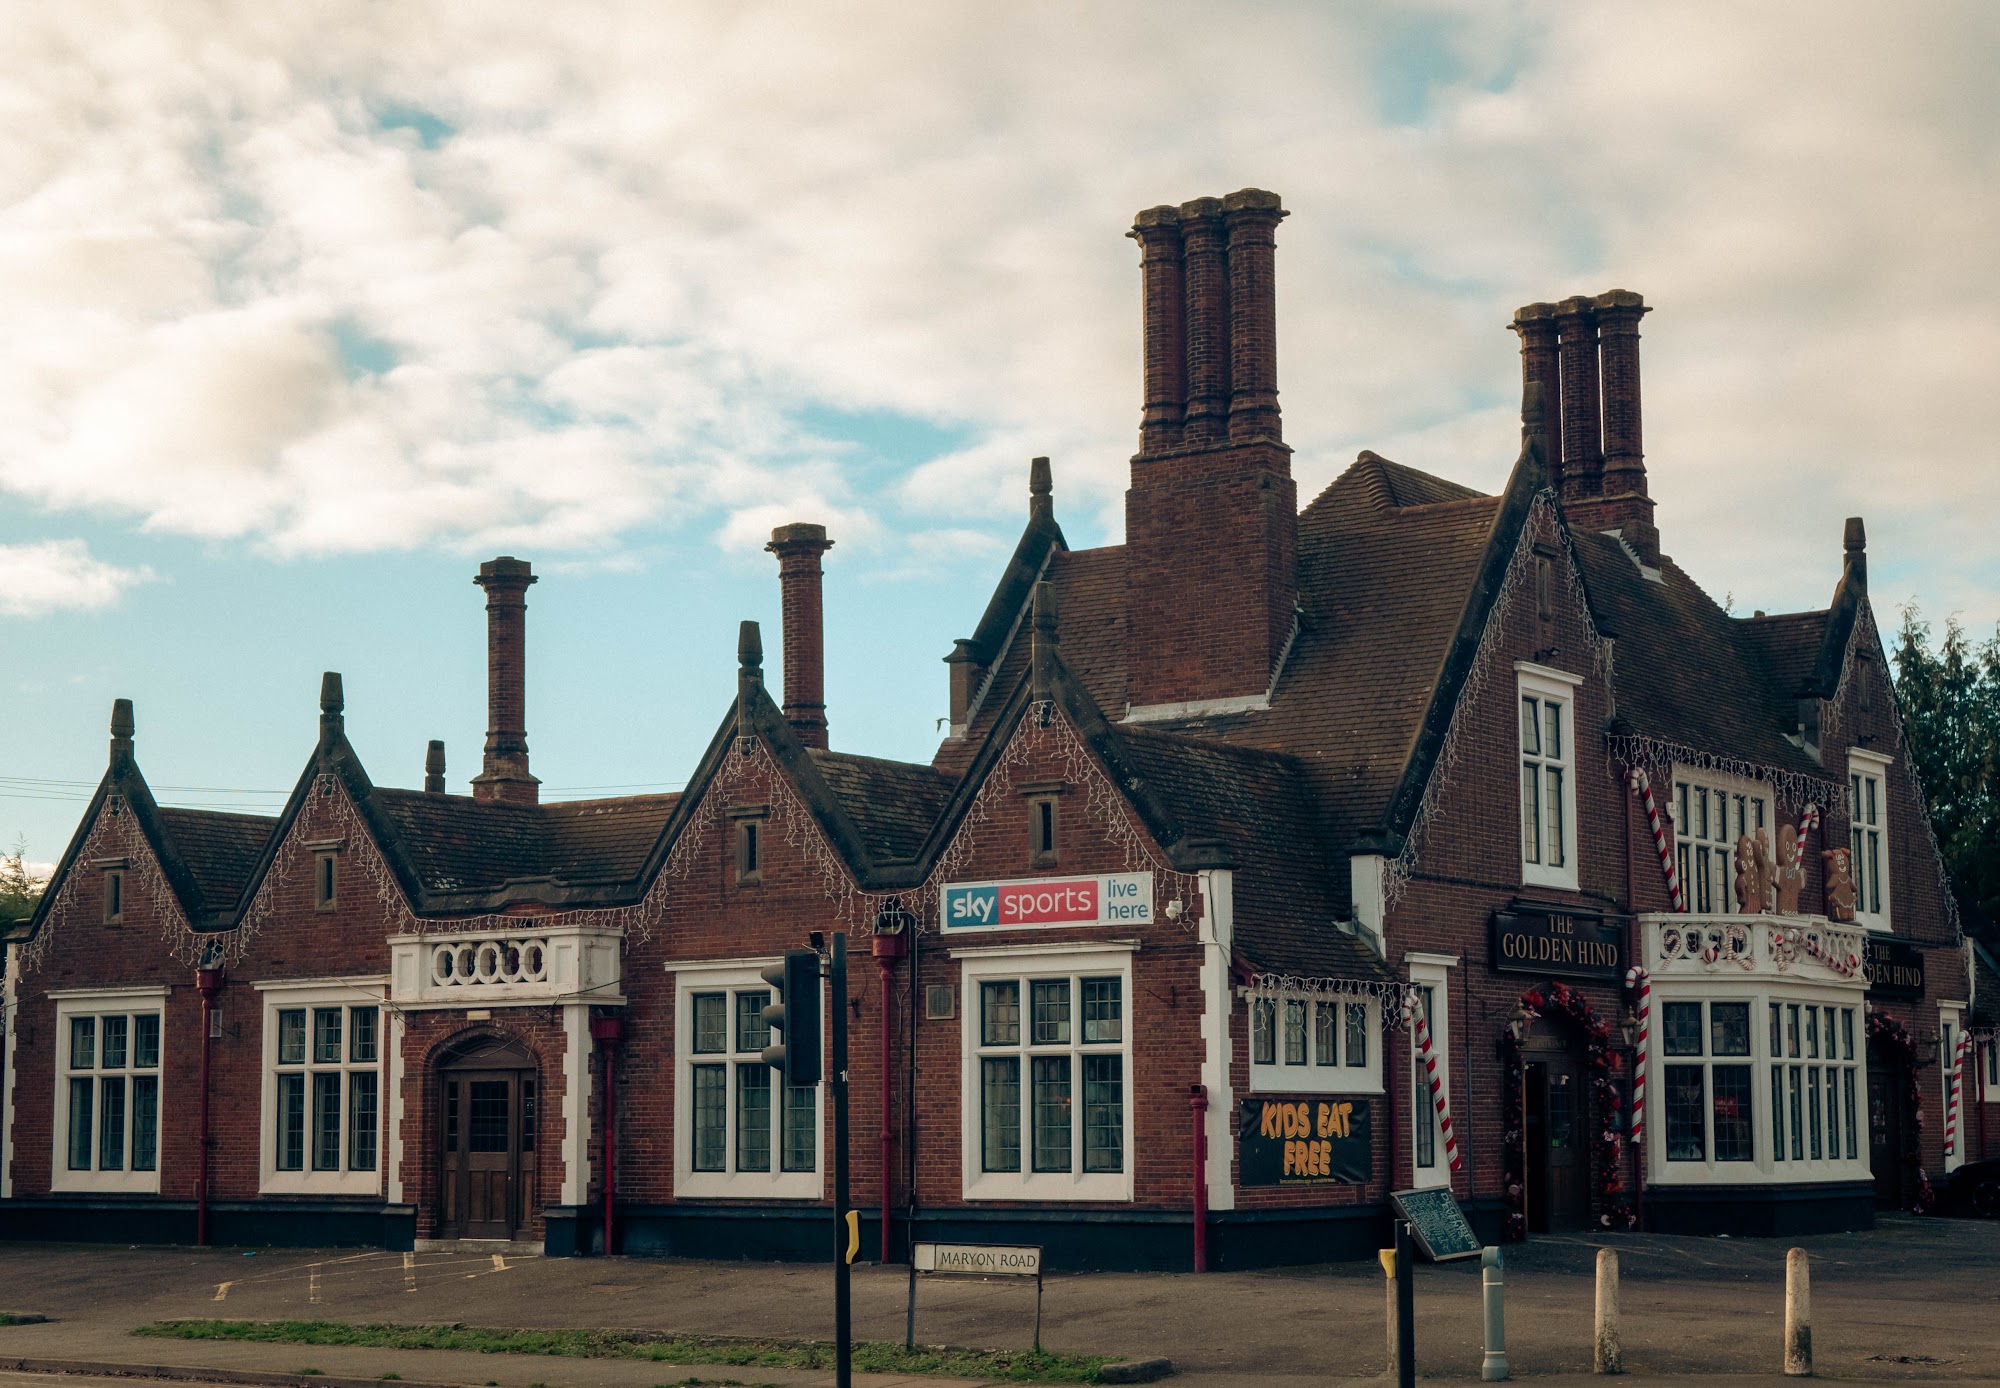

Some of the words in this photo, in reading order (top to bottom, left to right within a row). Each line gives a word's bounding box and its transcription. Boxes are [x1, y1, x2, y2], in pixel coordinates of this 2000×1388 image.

[1107, 879, 1138, 898] live
[953, 891, 995, 923] sky
[1004, 887, 1092, 921] sports
[1107, 901, 1149, 919] here
[1548, 914, 1574, 935] THE
[1502, 932, 1573, 963] GOLDEN
[1577, 940, 1618, 967] HIND
[1873, 944, 1891, 961] THE
[1868, 963, 1891, 984] DEN
[1893, 965, 1921, 987] HIND
[1261, 1101, 1311, 1139] KIDS
[1317, 1102, 1353, 1138] EAT
[1283, 1140, 1332, 1176] FREE
[1440, 1192, 1477, 1249] DECEMBER
[941, 1251, 996, 1266] MARYON
[1000, 1254, 1036, 1268] ROAD
